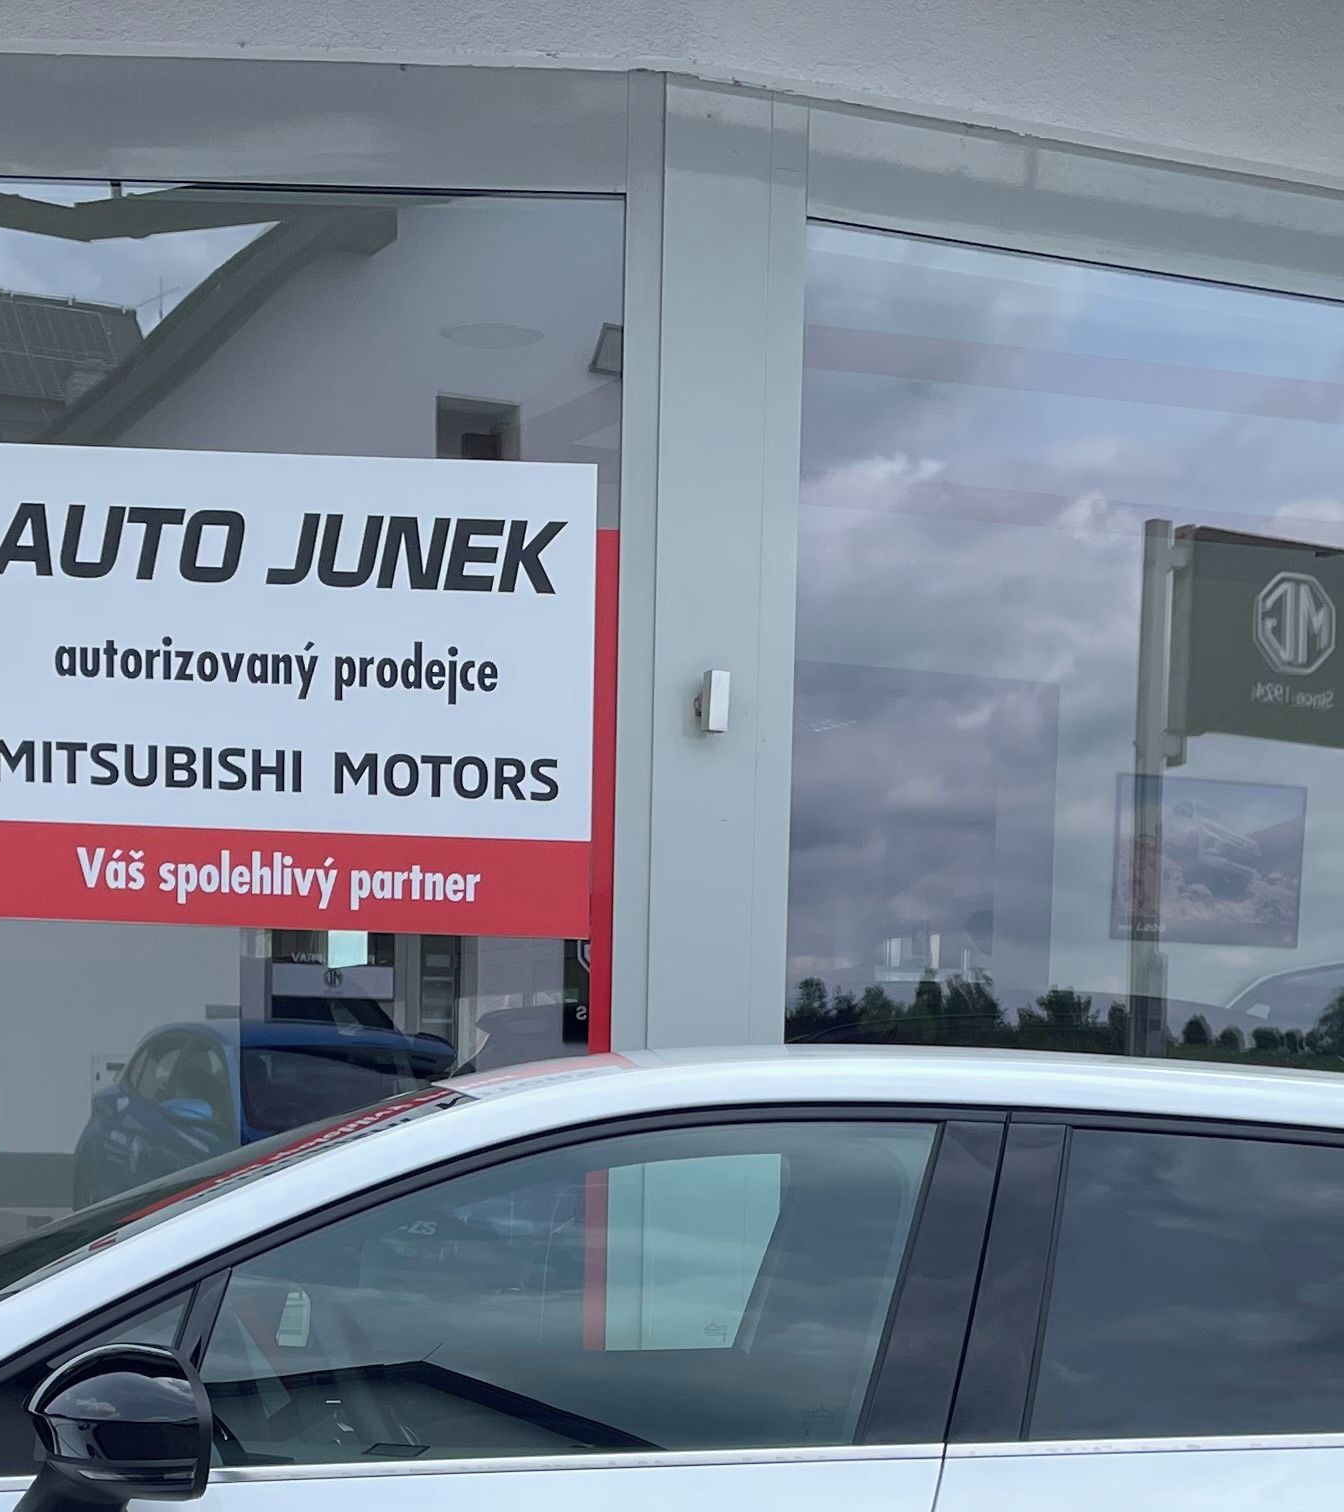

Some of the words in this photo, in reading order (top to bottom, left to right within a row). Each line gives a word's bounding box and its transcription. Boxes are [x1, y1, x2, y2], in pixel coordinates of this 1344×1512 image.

[265, 512, 569, 595] JUNEK
[54, 636, 319, 700] autorizovaný
[334, 641, 498, 705] prodejce
[334, 751, 559, 802] MOTORS
[76, 846, 145, 890] Váš
[158, 849, 338, 910] spolehlivý
[350, 864, 481, 911] partner
